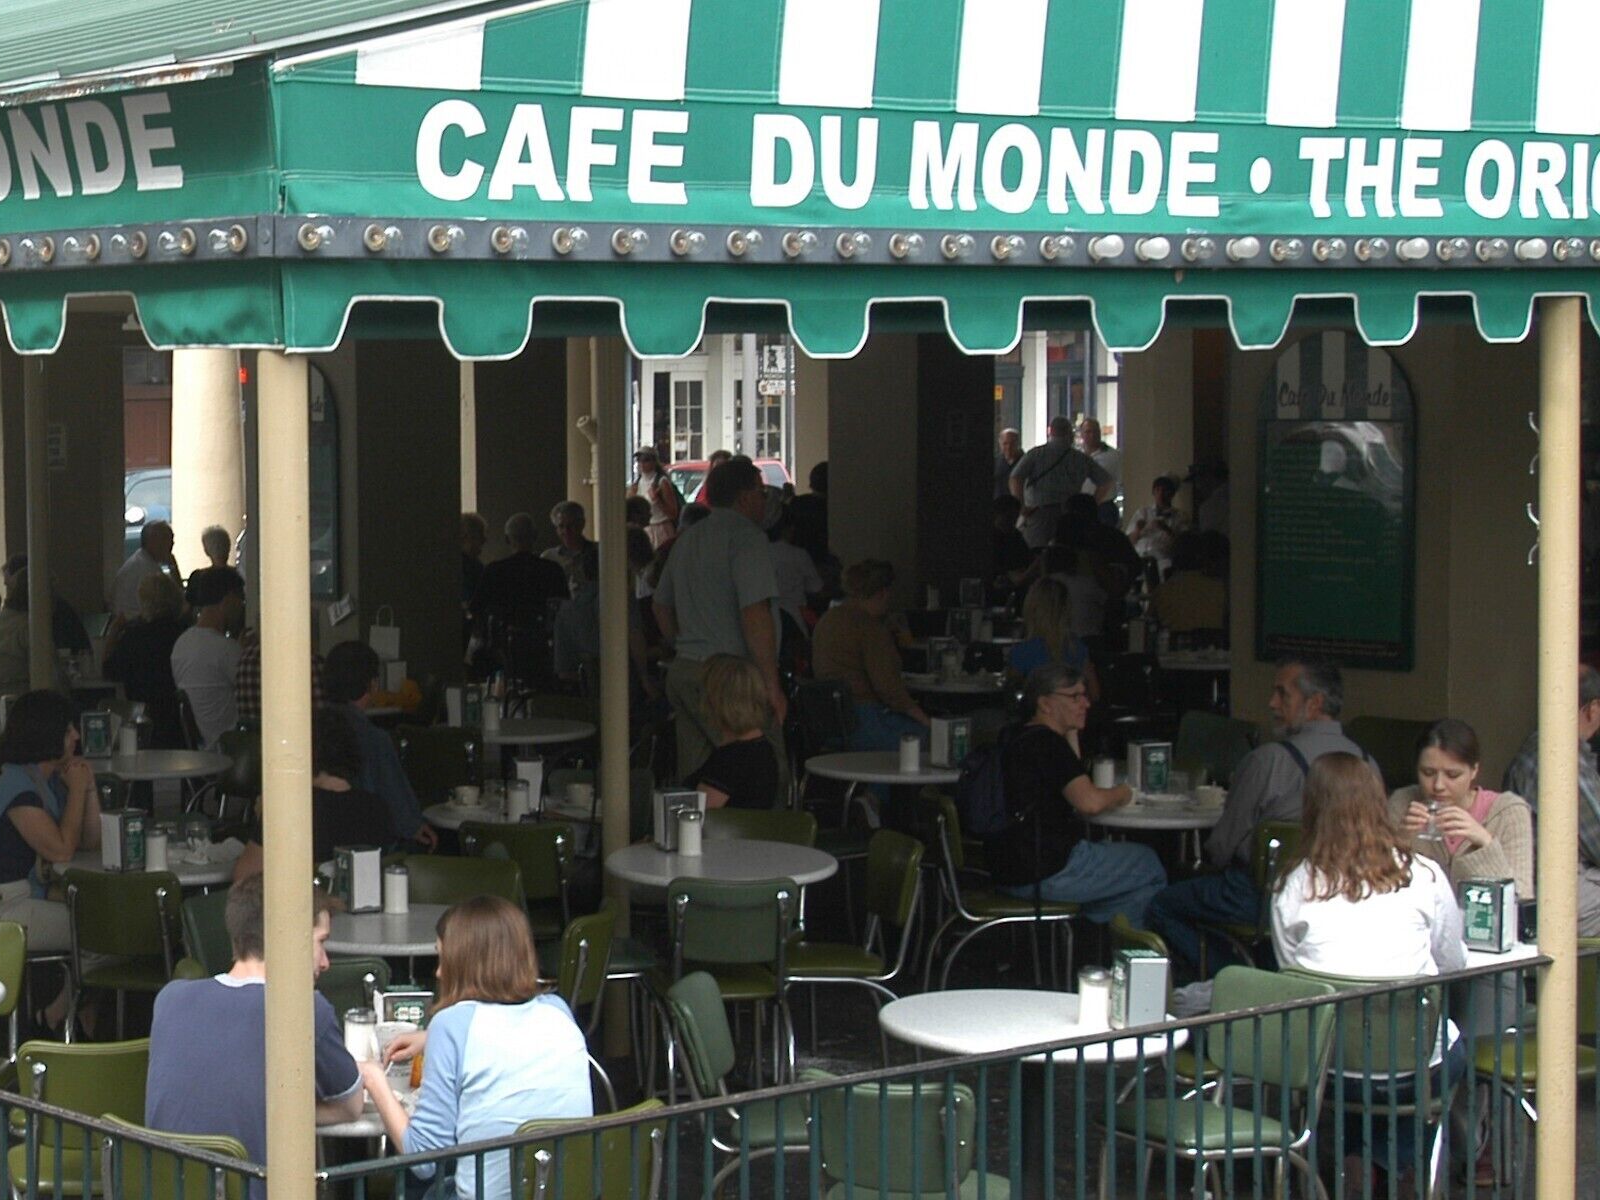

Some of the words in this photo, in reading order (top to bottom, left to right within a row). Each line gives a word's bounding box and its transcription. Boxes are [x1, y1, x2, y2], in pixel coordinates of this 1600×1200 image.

[415, 99, 690, 204] CAFE
[749, 112, 879, 210] DU
[907, 119, 1220, 218] MONDE
[1298, 135, 1445, 219] THE
[1464, 138, 1600, 220] ORI
